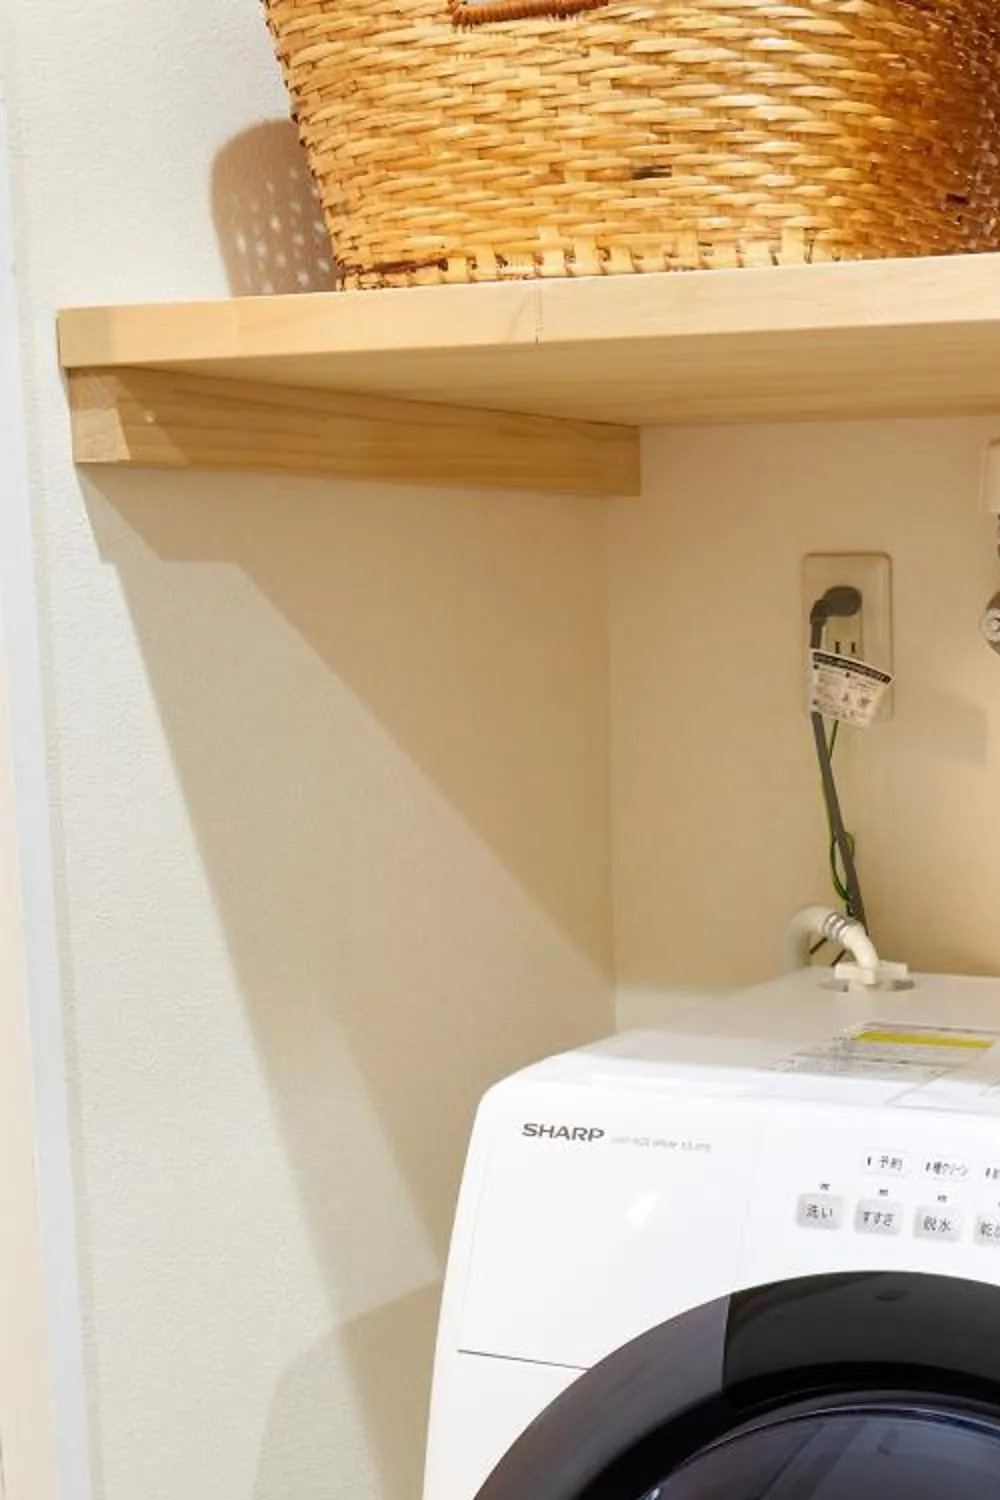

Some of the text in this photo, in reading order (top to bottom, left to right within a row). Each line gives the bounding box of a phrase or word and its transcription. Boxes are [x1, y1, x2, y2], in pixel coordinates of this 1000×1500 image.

[522, 1122, 605, 1142] SHARP
[805, 1203, 834, 1220] 洗い
[922, 1214, 952, 1233] 脱水
